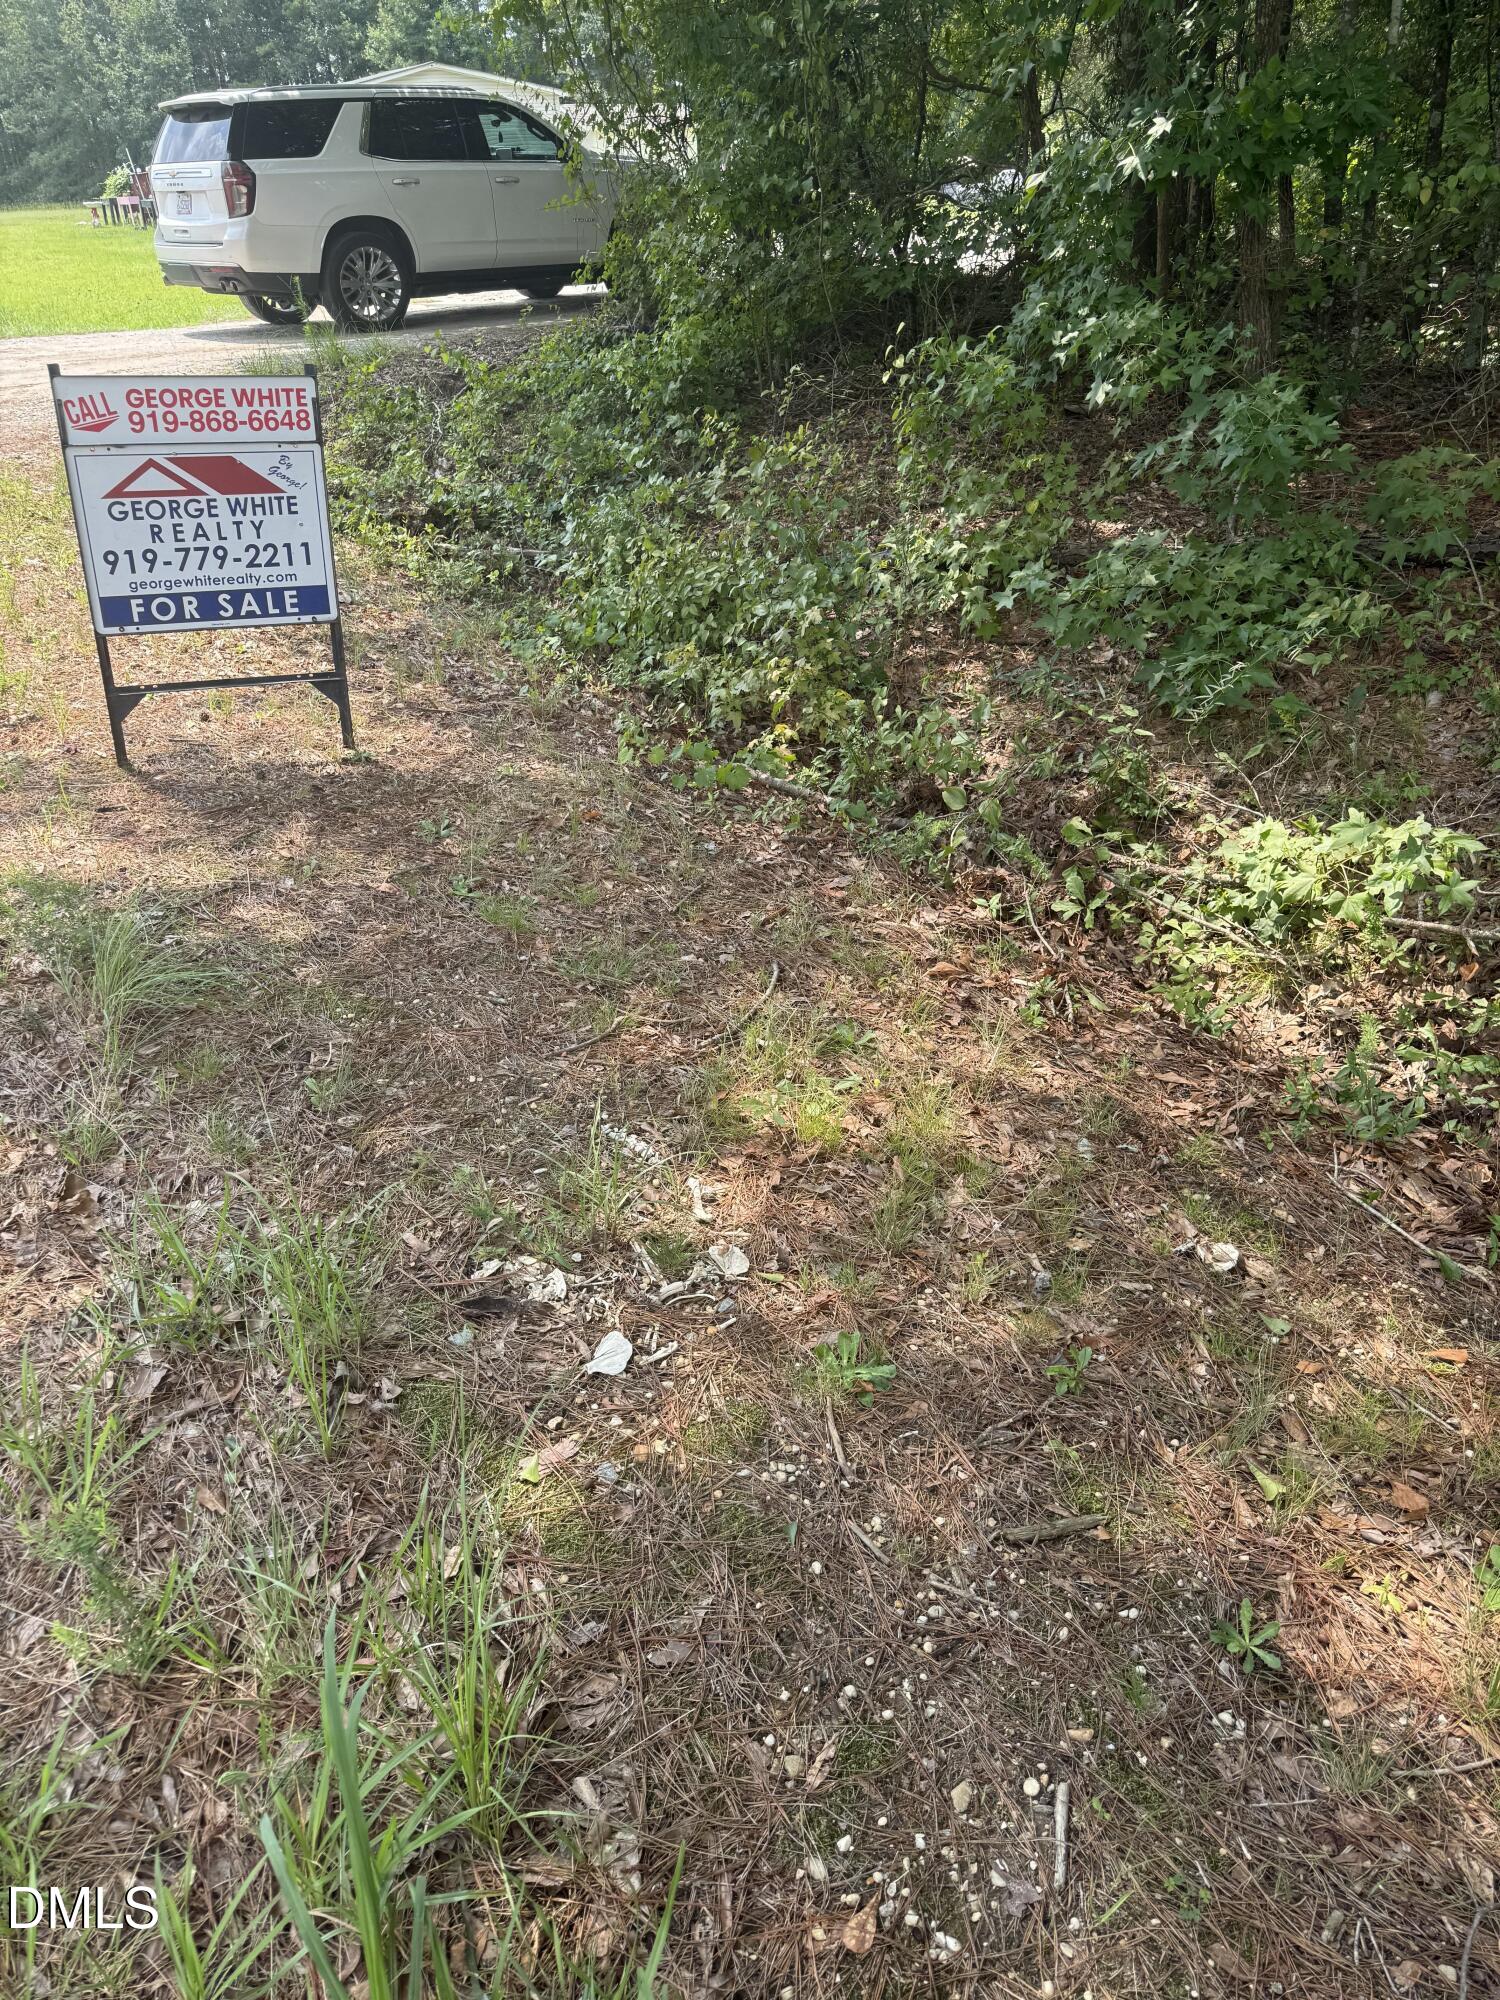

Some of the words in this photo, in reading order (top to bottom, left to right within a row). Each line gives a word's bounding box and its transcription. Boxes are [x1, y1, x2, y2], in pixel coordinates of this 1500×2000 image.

[63, 391, 118, 425] CALL
[125, 388, 225, 409] GEORGE
[231, 387, 308, 408] WHITE
[128, 409, 311, 434] 919-868-6648
[278, 454, 293, 470] By
[267, 466, 308, 490] George!
[107, 498, 219, 521] GEORGE
[226, 495, 299, 517] WHITE
[149, 520, 264, 544] REALTY
[102, 541, 312, 575] 919-779-2211
[128, 572, 298, 593] georgewhiterealty.com
[130, 596, 200, 623] FOR
[218, 590, 299, 617] SALE
